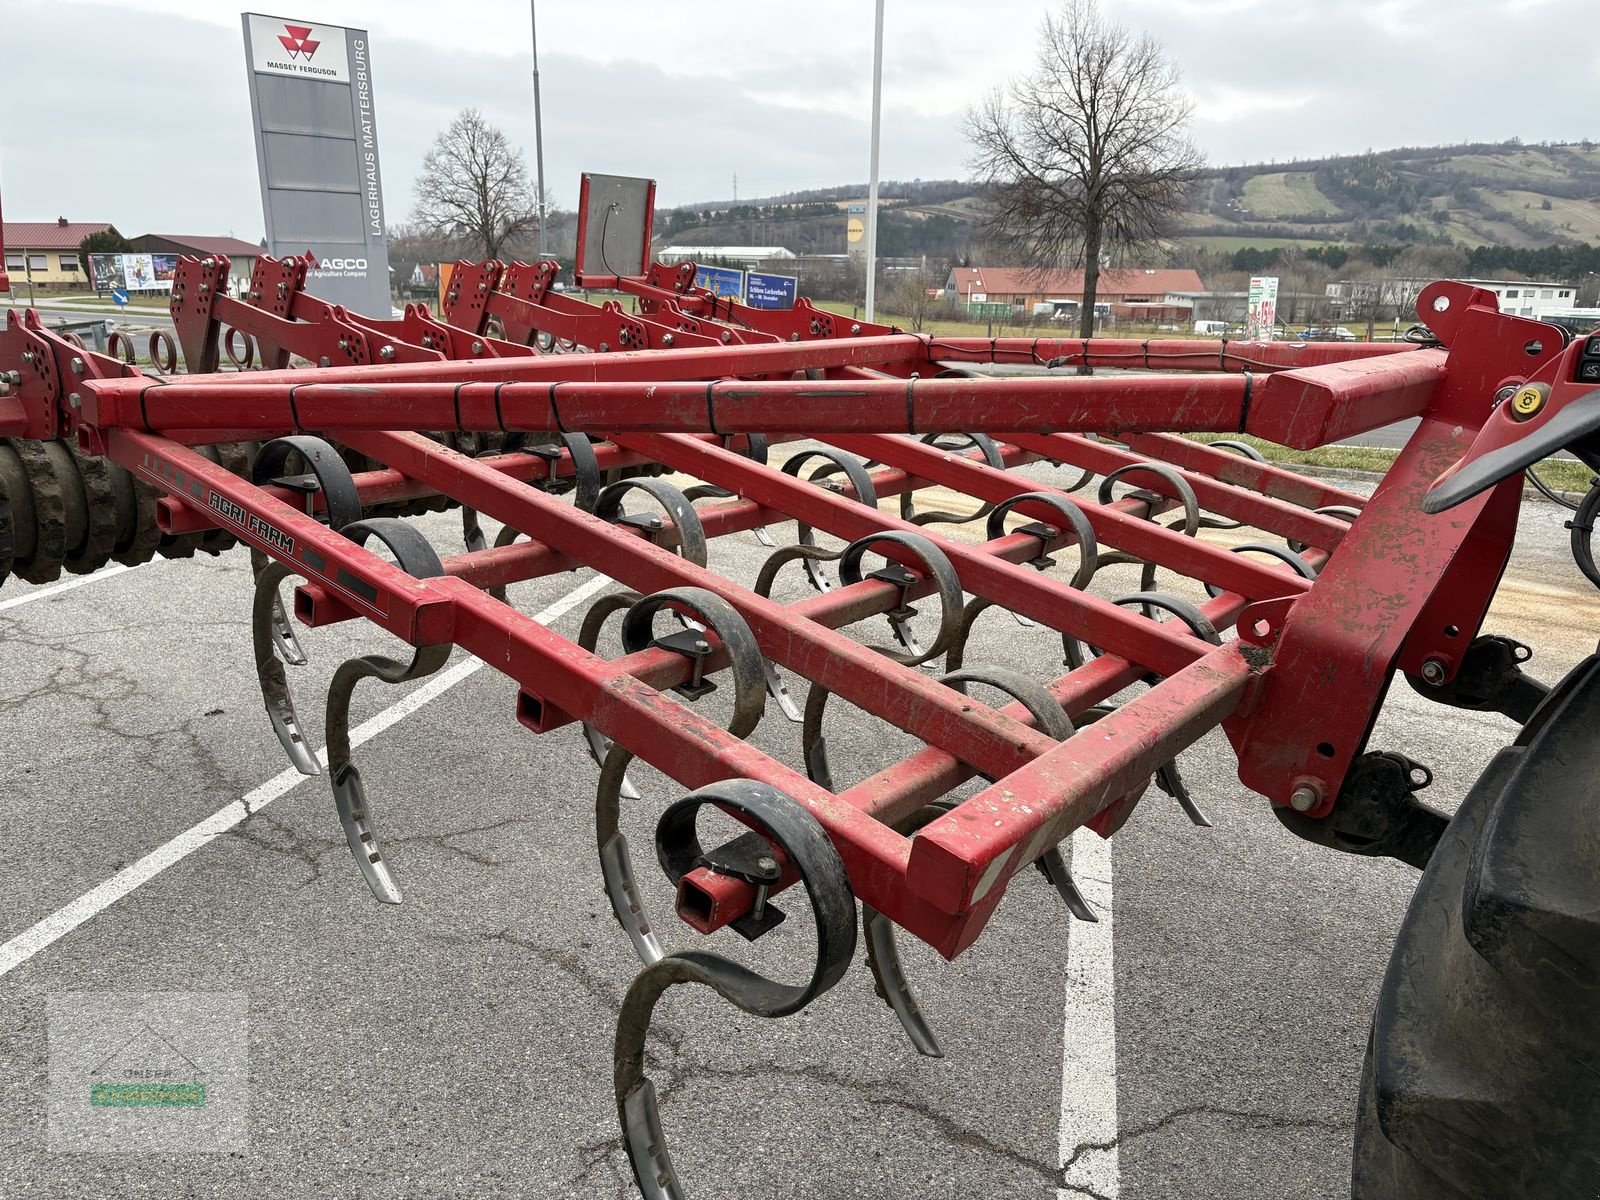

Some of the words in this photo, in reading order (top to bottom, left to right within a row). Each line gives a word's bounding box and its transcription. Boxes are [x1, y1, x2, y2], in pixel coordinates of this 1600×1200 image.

[267, 61, 297, 71] MASSEY
[299, 65, 337, 76] FERGUSON
[354, 39, 374, 148] MATTERSBURG
[365, 152, 381, 236] LAGERHAUS
[314, 271, 342, 279] Agriculture
[343, 270, 367, 278] Company
[320, 258, 368, 270] AGCO
[208, 490, 246, 526] AGRI
[248, 513, 295, 555] FARM
